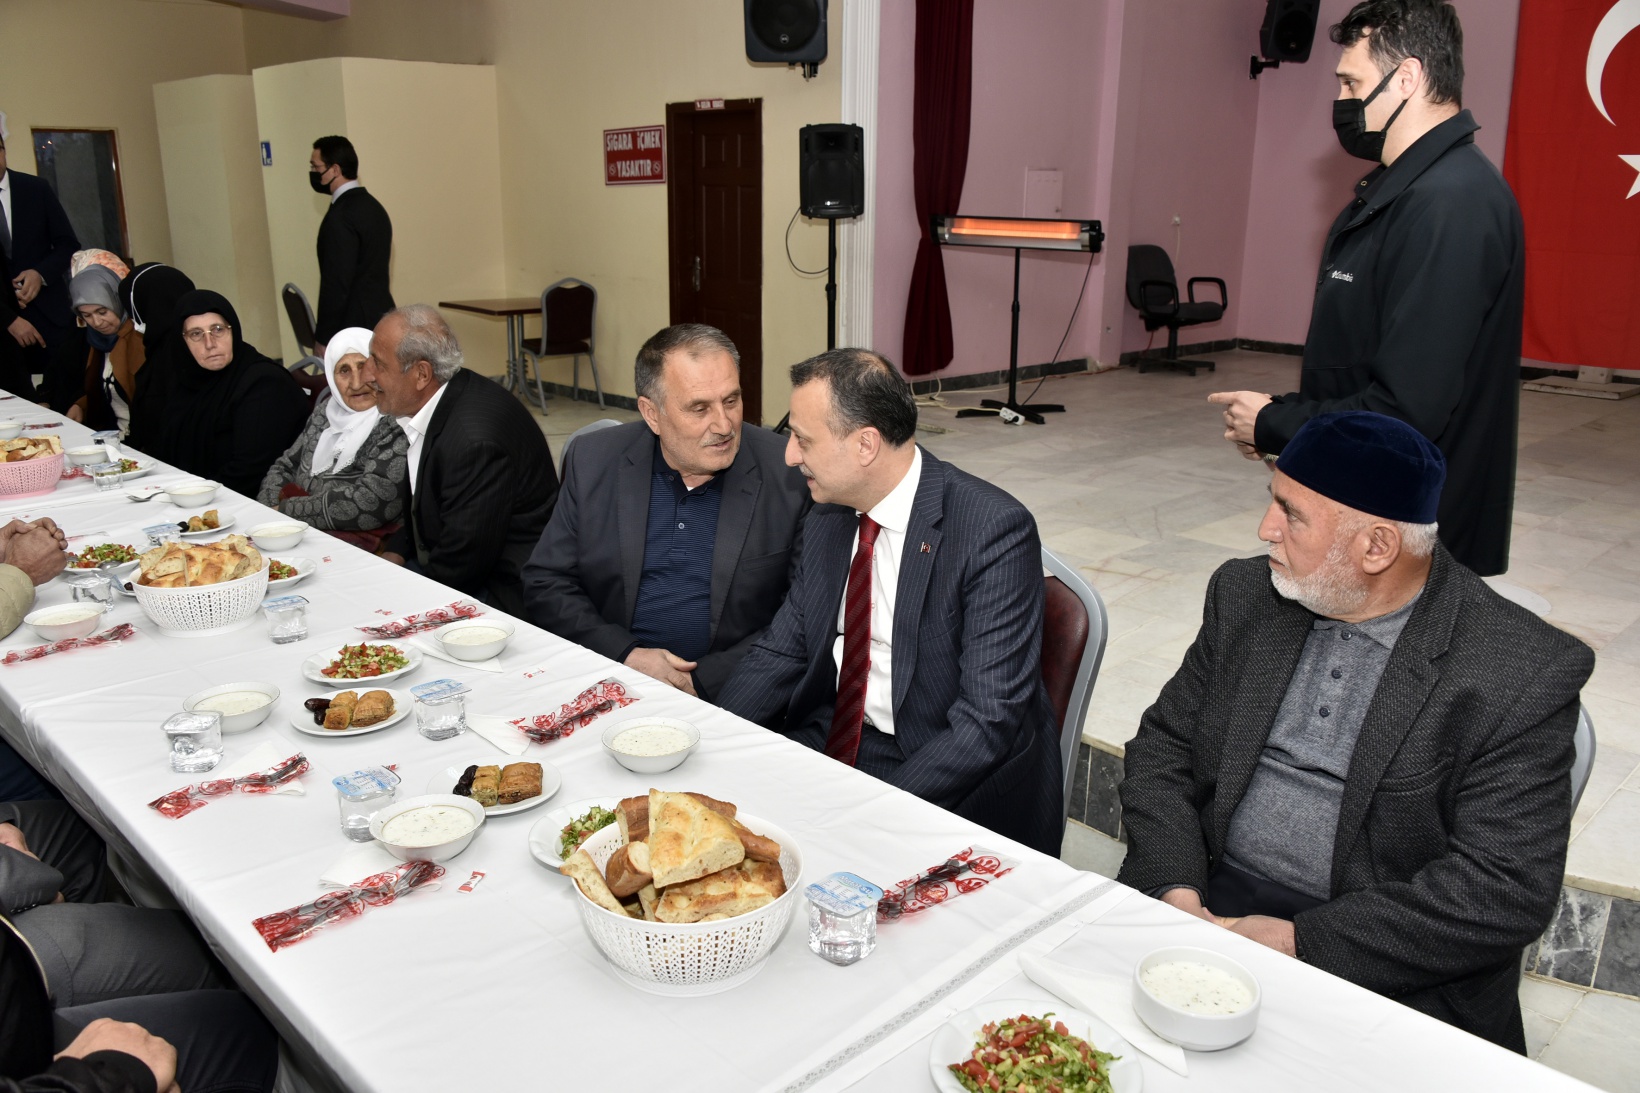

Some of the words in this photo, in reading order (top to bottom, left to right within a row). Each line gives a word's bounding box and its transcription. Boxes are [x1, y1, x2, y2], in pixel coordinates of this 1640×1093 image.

[606, 133, 633, 151] SİGARA
[637, 130, 661, 152] İÇMEK
[616, 159, 652, 178] YASAKTIR
